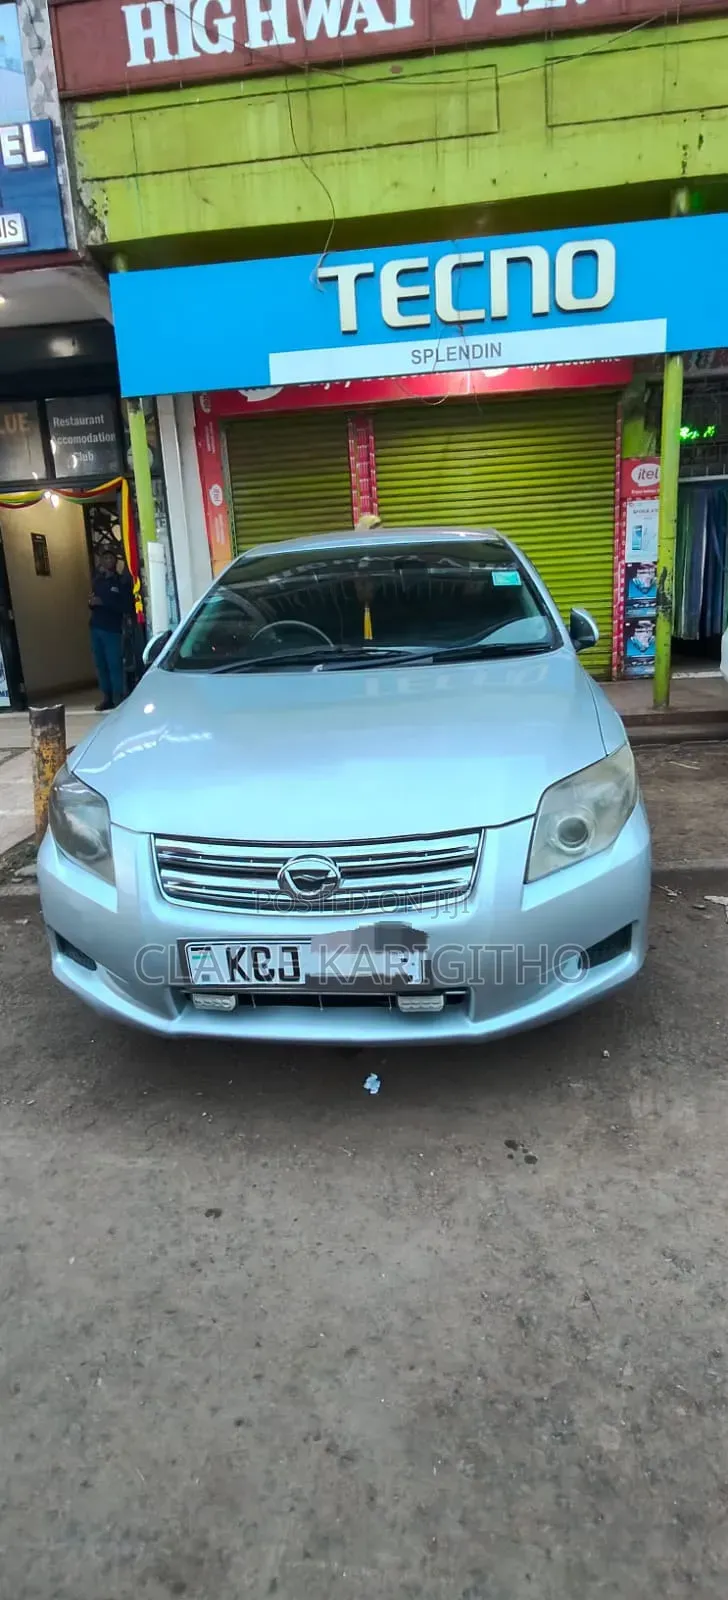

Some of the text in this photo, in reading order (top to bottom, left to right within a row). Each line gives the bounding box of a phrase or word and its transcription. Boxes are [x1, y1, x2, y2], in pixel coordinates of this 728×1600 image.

[317, 238, 616, 335] TECNO
[411, 342, 502, 365] SPLENDIN
[53, 414, 105, 428] Restaurant
[638, 468, 659, 481] itel
